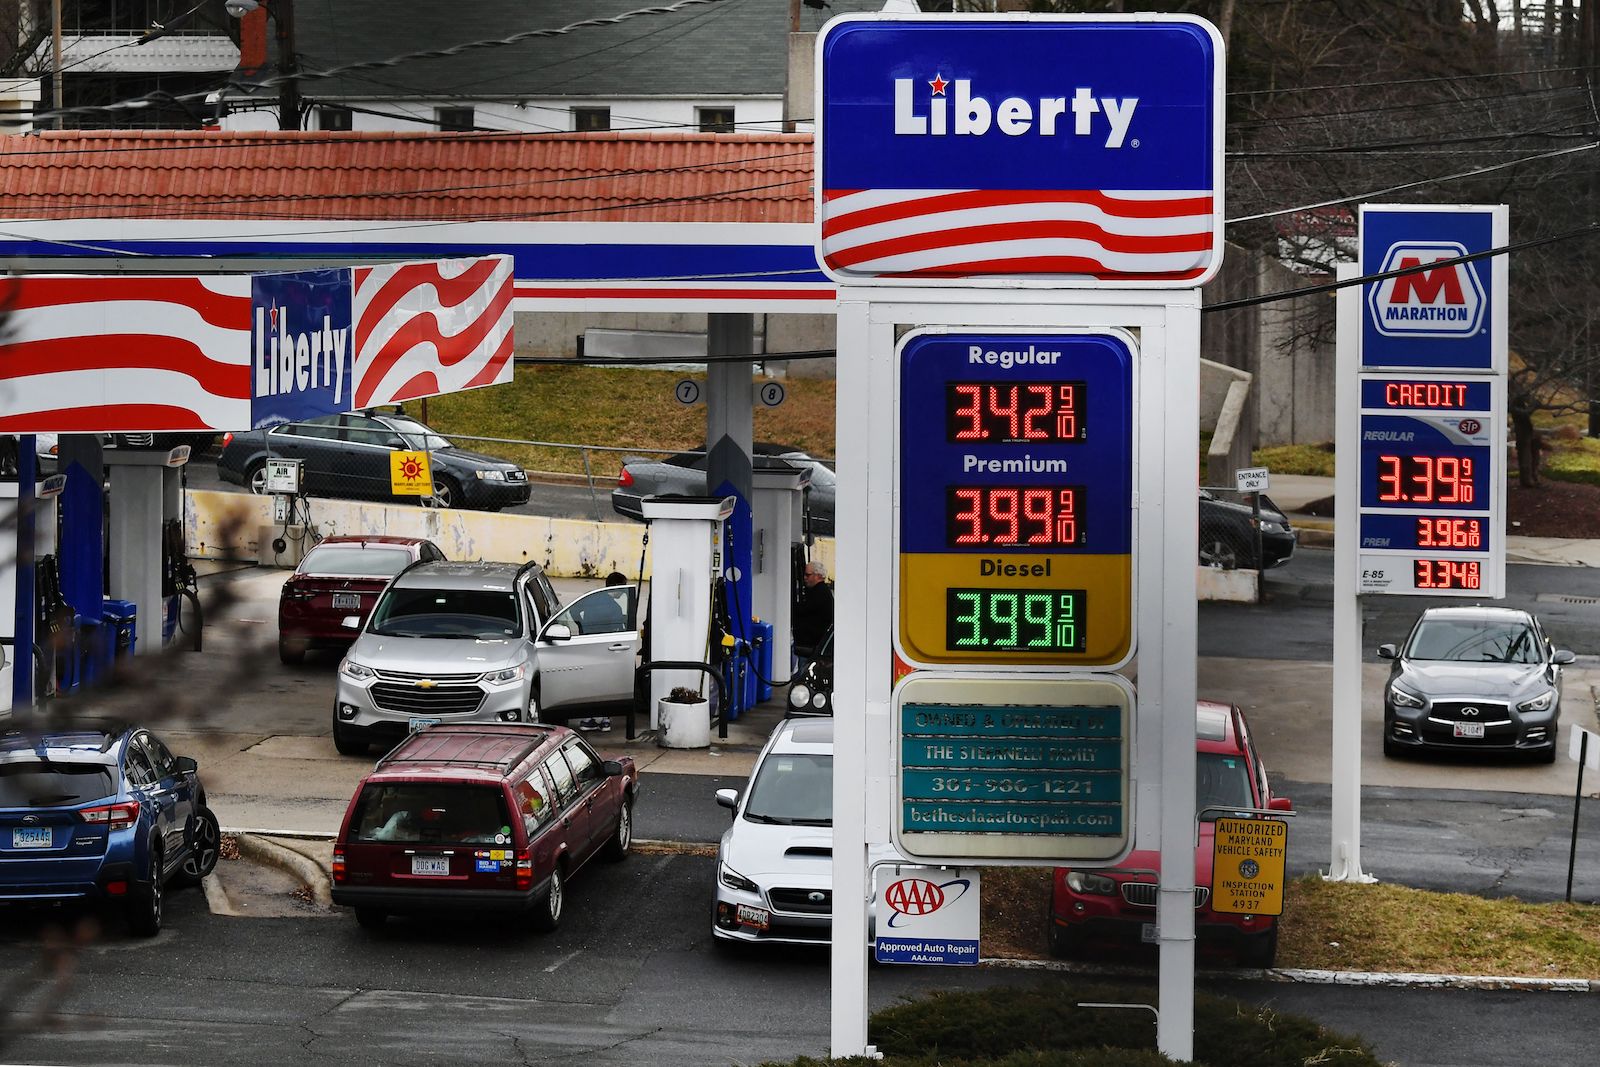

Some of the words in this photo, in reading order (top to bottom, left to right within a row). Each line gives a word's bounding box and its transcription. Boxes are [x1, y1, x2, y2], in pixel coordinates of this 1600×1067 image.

[895, 74, 1139, 148] Liberty
[1386, 307, 1468, 321] MARATHON
[256, 297, 347, 404] Liberty
[968, 346, 1062, 369] Regular
[683, 386, 692, 399] 7
[768, 388, 776, 400] 8
[1386, 383, 1467, 407] CREDIT
[956, 386, 1052, 438] 3.42
[1460, 420, 1479, 432] STP
[1364, 431, 1415, 442] REGULAR
[276, 467, 288, 475] AIR
[963, 454, 1068, 473] Premium
[1239, 471, 1266, 480] ENTRANCE
[1380, 456, 1459, 502] 3.39
[956, 490, 1052, 543] 3.99
[1363, 537, 1391, 546] PREM
[1418, 519, 1467, 547] 3.96
[980, 558, 1052, 577] Diesel
[1362, 570, 1385, 579] E-85
[1417, 560, 1466, 587] 3.34
[956, 593, 1052, 646] 3.99
[915, 712, 976, 728] OWNED
[925, 745, 954, 761] THE
[959, 745, 1042, 762] STEFANELLI
[911, 807, 1114, 828] bethesdaautorepair.com
[1219, 822, 1283, 836] AUTHORIZED
[1228, 835, 1273, 846] MARYLAND
[1217, 845, 1251, 856] VEHICLE
[1253, 847, 1283, 857] SAFETY
[1222, 881, 1274, 891] INSPECTION
[1230, 889, 1265, 898] STATION
[888, 879, 941, 915] AAA
[1232, 899, 1260, 910] 4937
[880, 942, 922, 953] Approved
[923, 943, 945, 953] Auto
[947, 944, 976, 955] Repair
[911, 954, 944, 962] AAA.com
